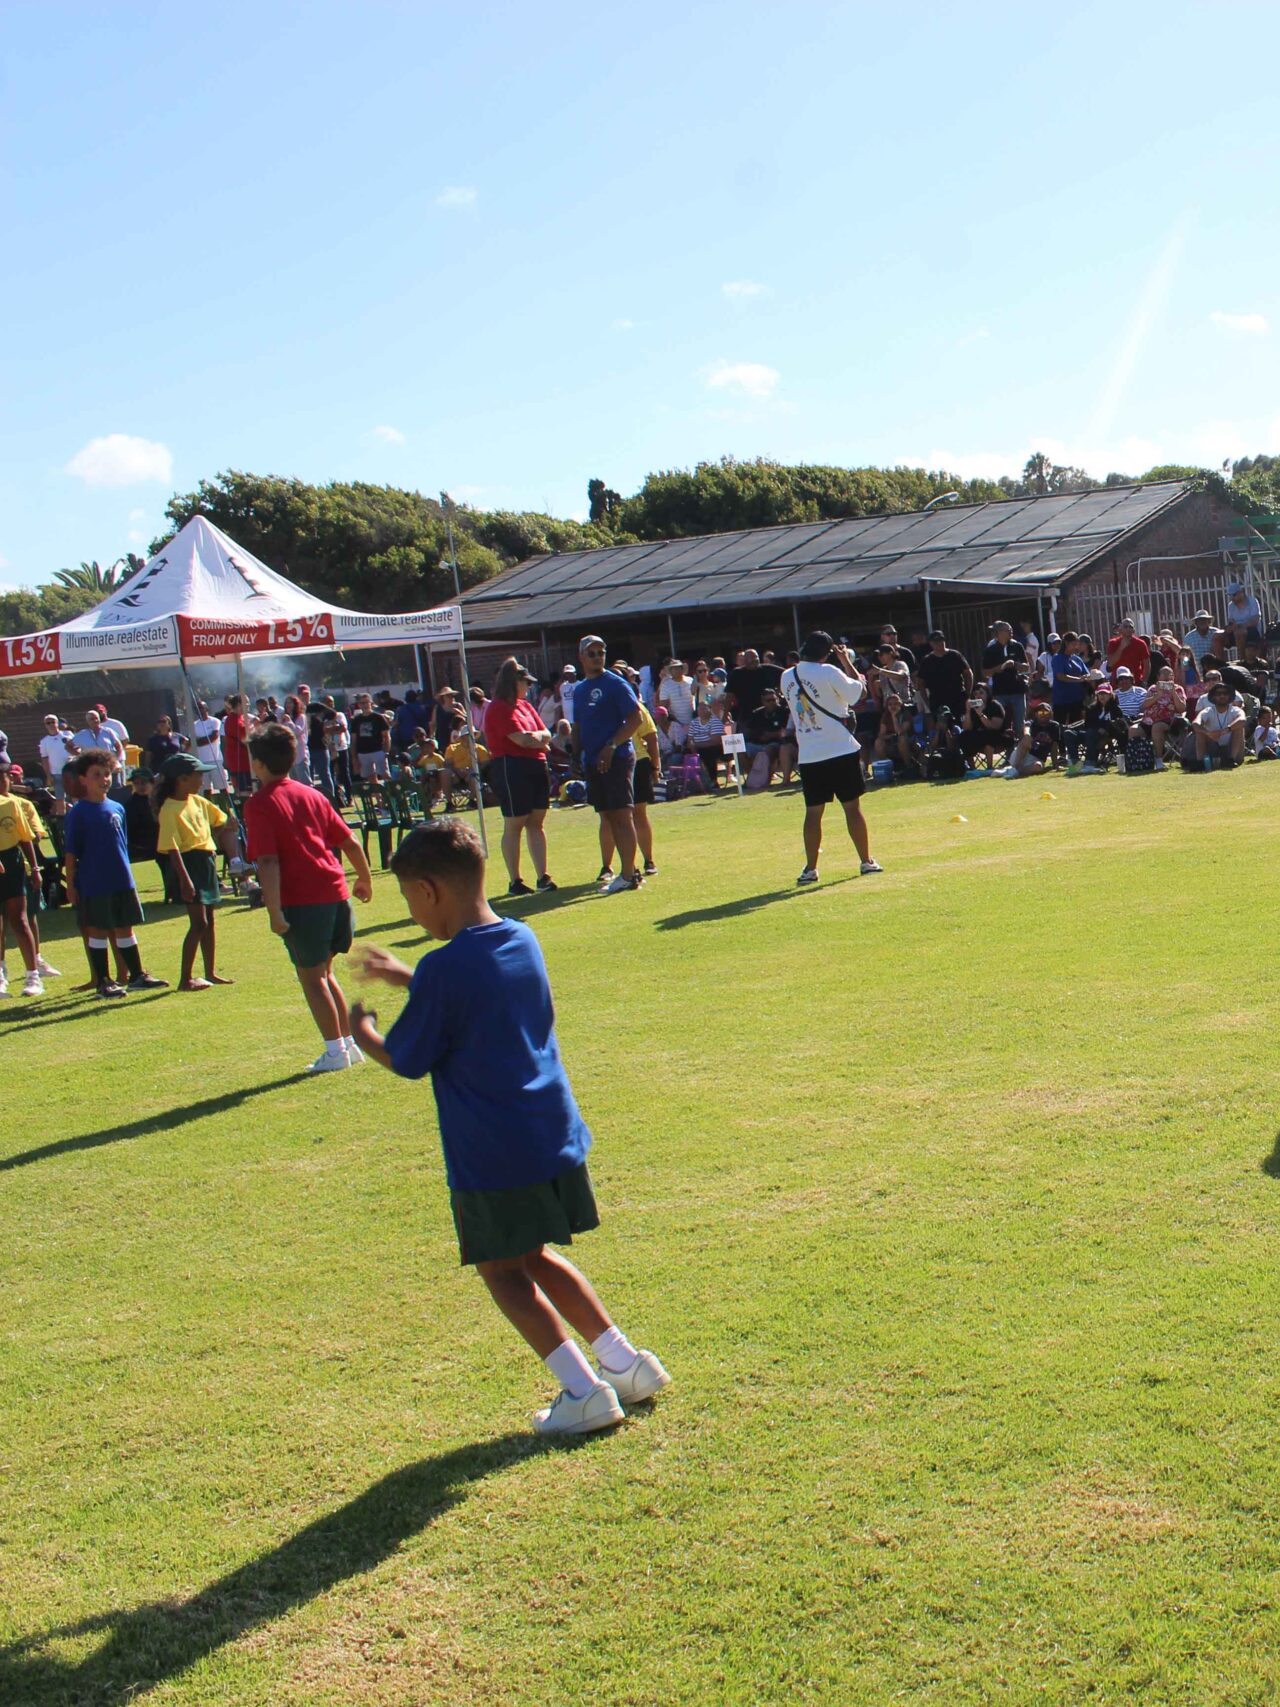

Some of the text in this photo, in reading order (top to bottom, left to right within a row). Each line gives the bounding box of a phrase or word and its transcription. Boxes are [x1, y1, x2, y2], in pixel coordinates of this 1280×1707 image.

[66, 626, 169, 649] illuminate.realestate
[192, 633, 258, 647] FROM ONLY
[4, 636, 56, 667] 1.5%
